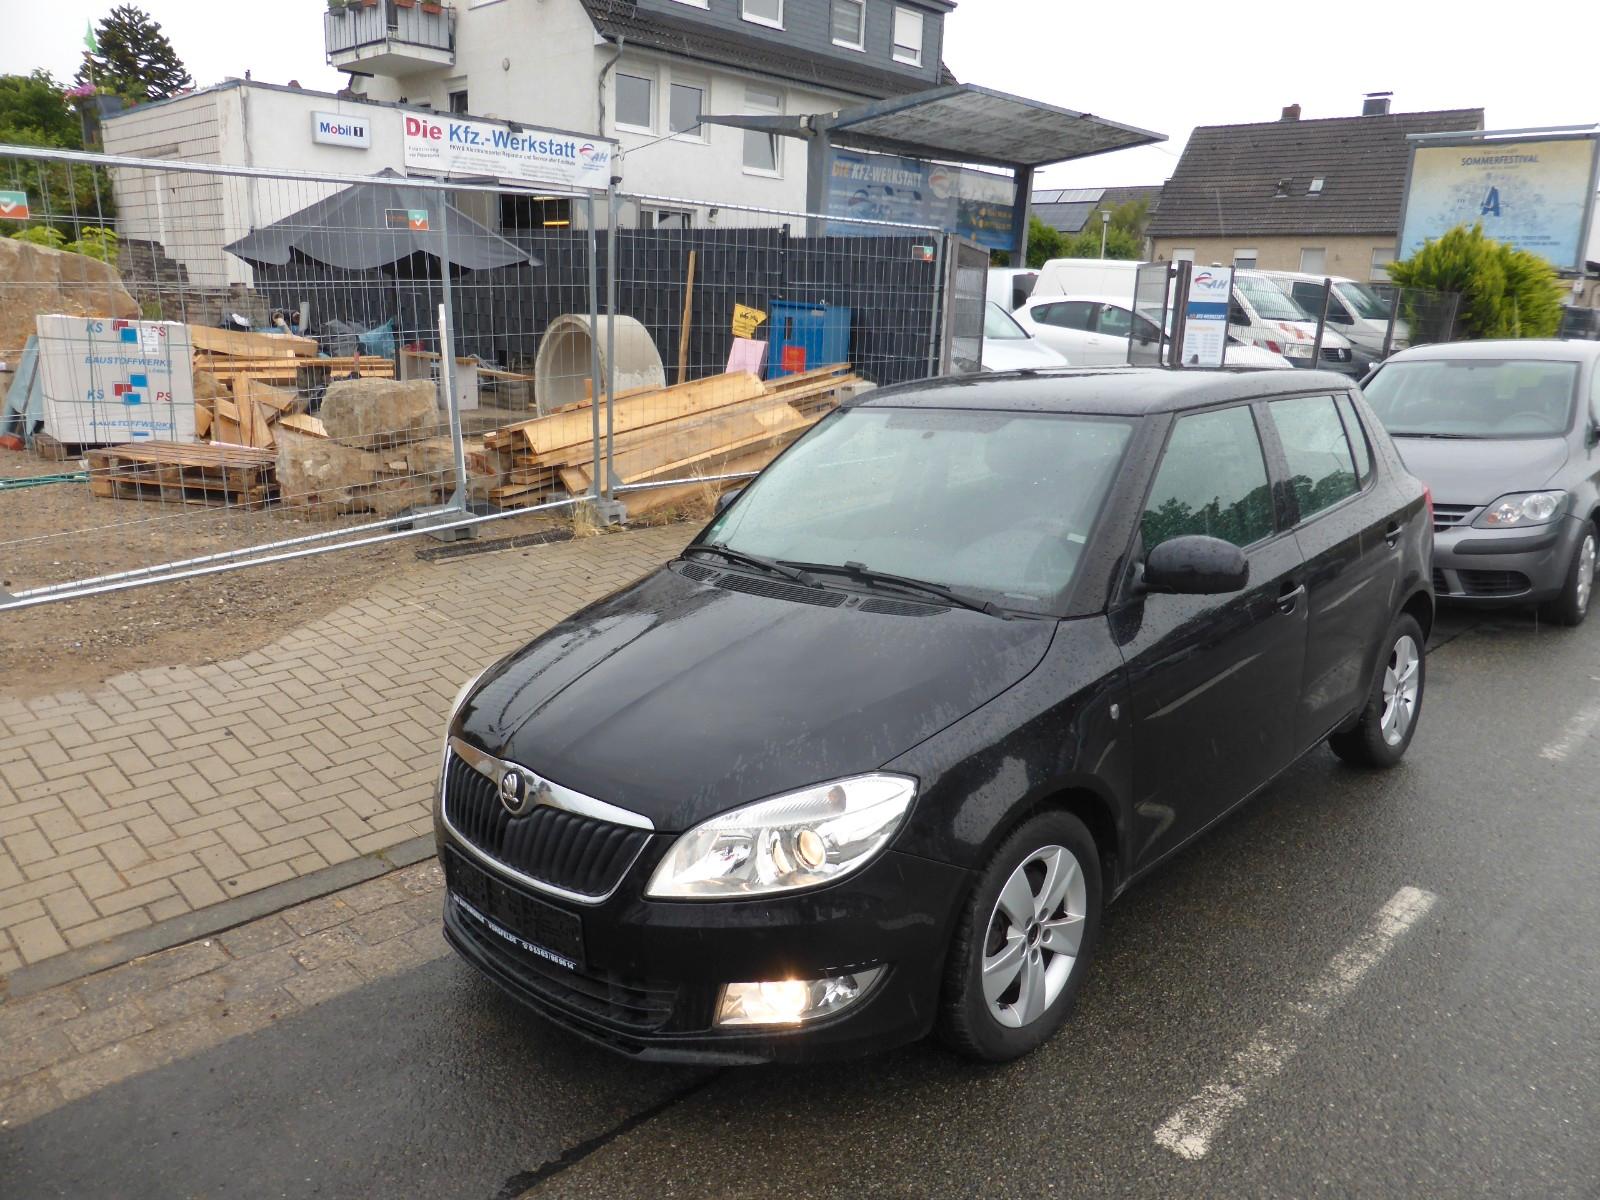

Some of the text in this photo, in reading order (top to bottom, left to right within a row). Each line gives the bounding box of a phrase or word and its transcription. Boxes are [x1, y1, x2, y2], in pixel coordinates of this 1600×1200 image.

[320, 121, 364, 137] Mobil 1
[406, 117, 576, 158] Die Kfz.-Werkstatt
[591, 152, 609, 162] AH
[1461, 154, 1539, 166] SOMMERFESTIVAL
[851, 163, 922, 187] KFZ-WERKSTATT
[1209, 279, 1227, 289] AH
[86, 321, 103, 333] KS
[87, 389, 105, 400] KS
[156, 391, 172, 401] PS
